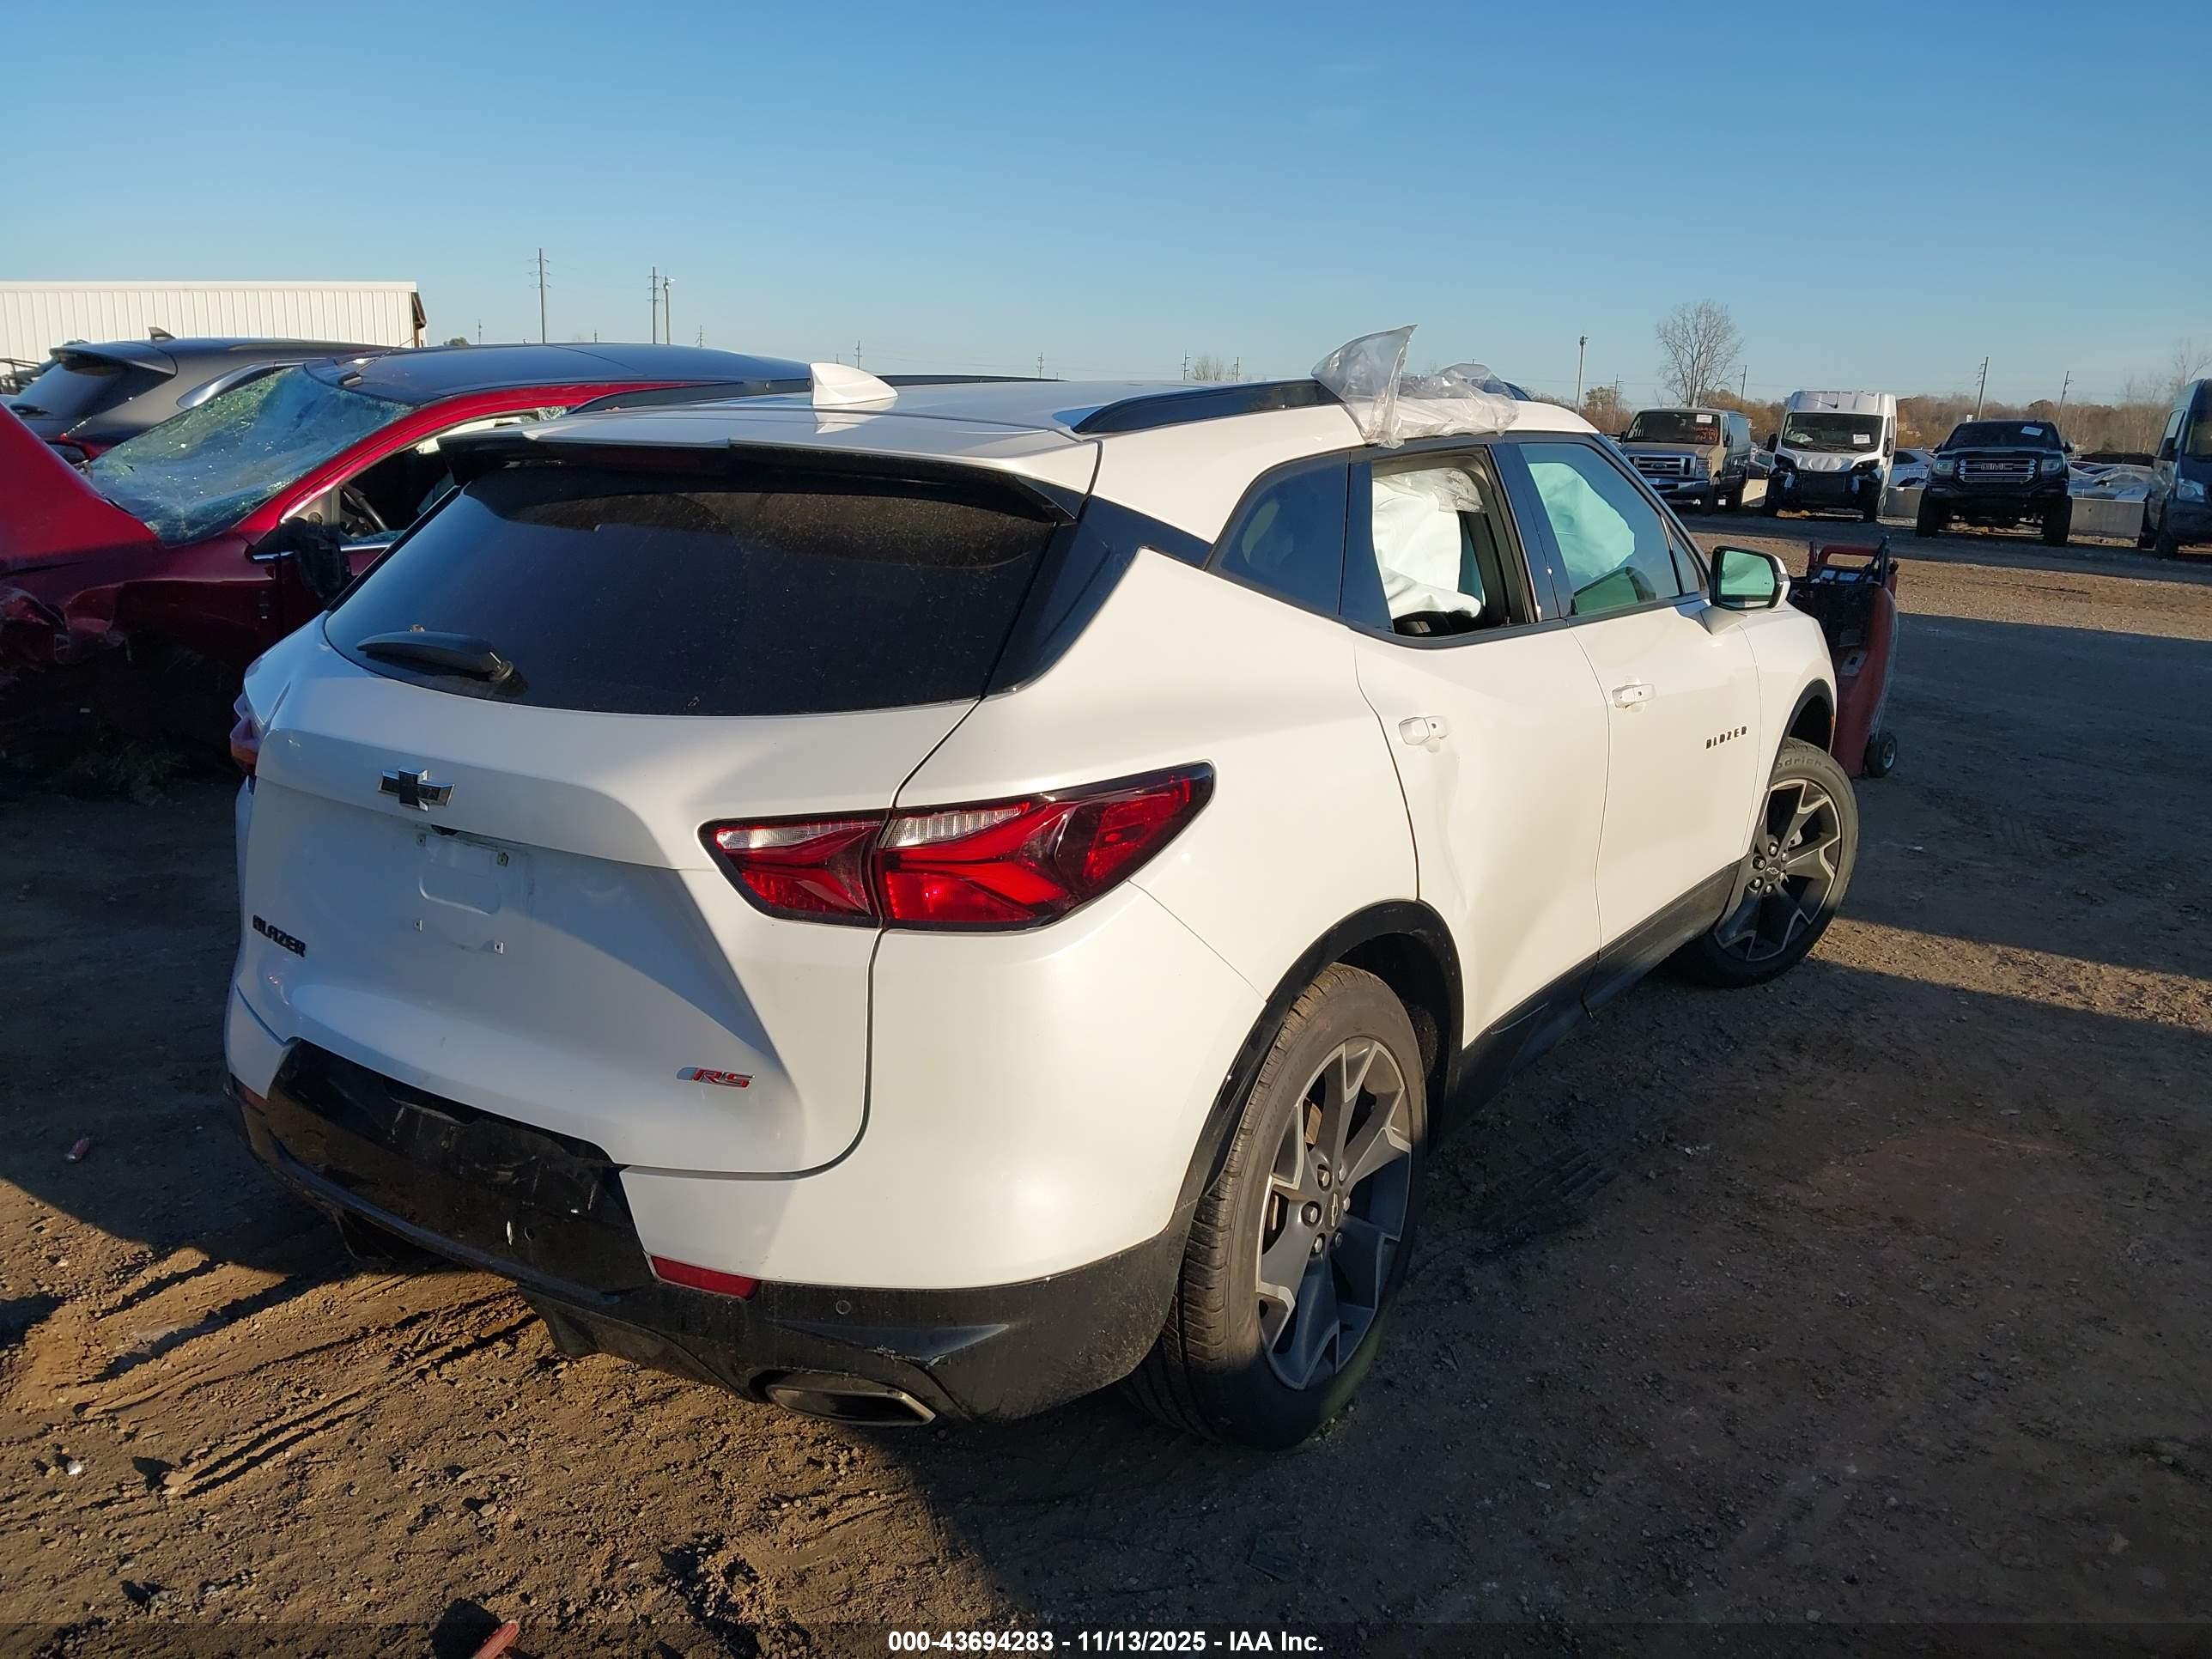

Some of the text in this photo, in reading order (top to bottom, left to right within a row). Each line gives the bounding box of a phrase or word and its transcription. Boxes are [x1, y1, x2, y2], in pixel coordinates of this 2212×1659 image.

[1980, 462, 2014, 471] GMC
[1705, 726, 1747, 750] BLAZER
[252, 914, 306, 958] BLAZER
[691, 1068, 754, 1089] RS
